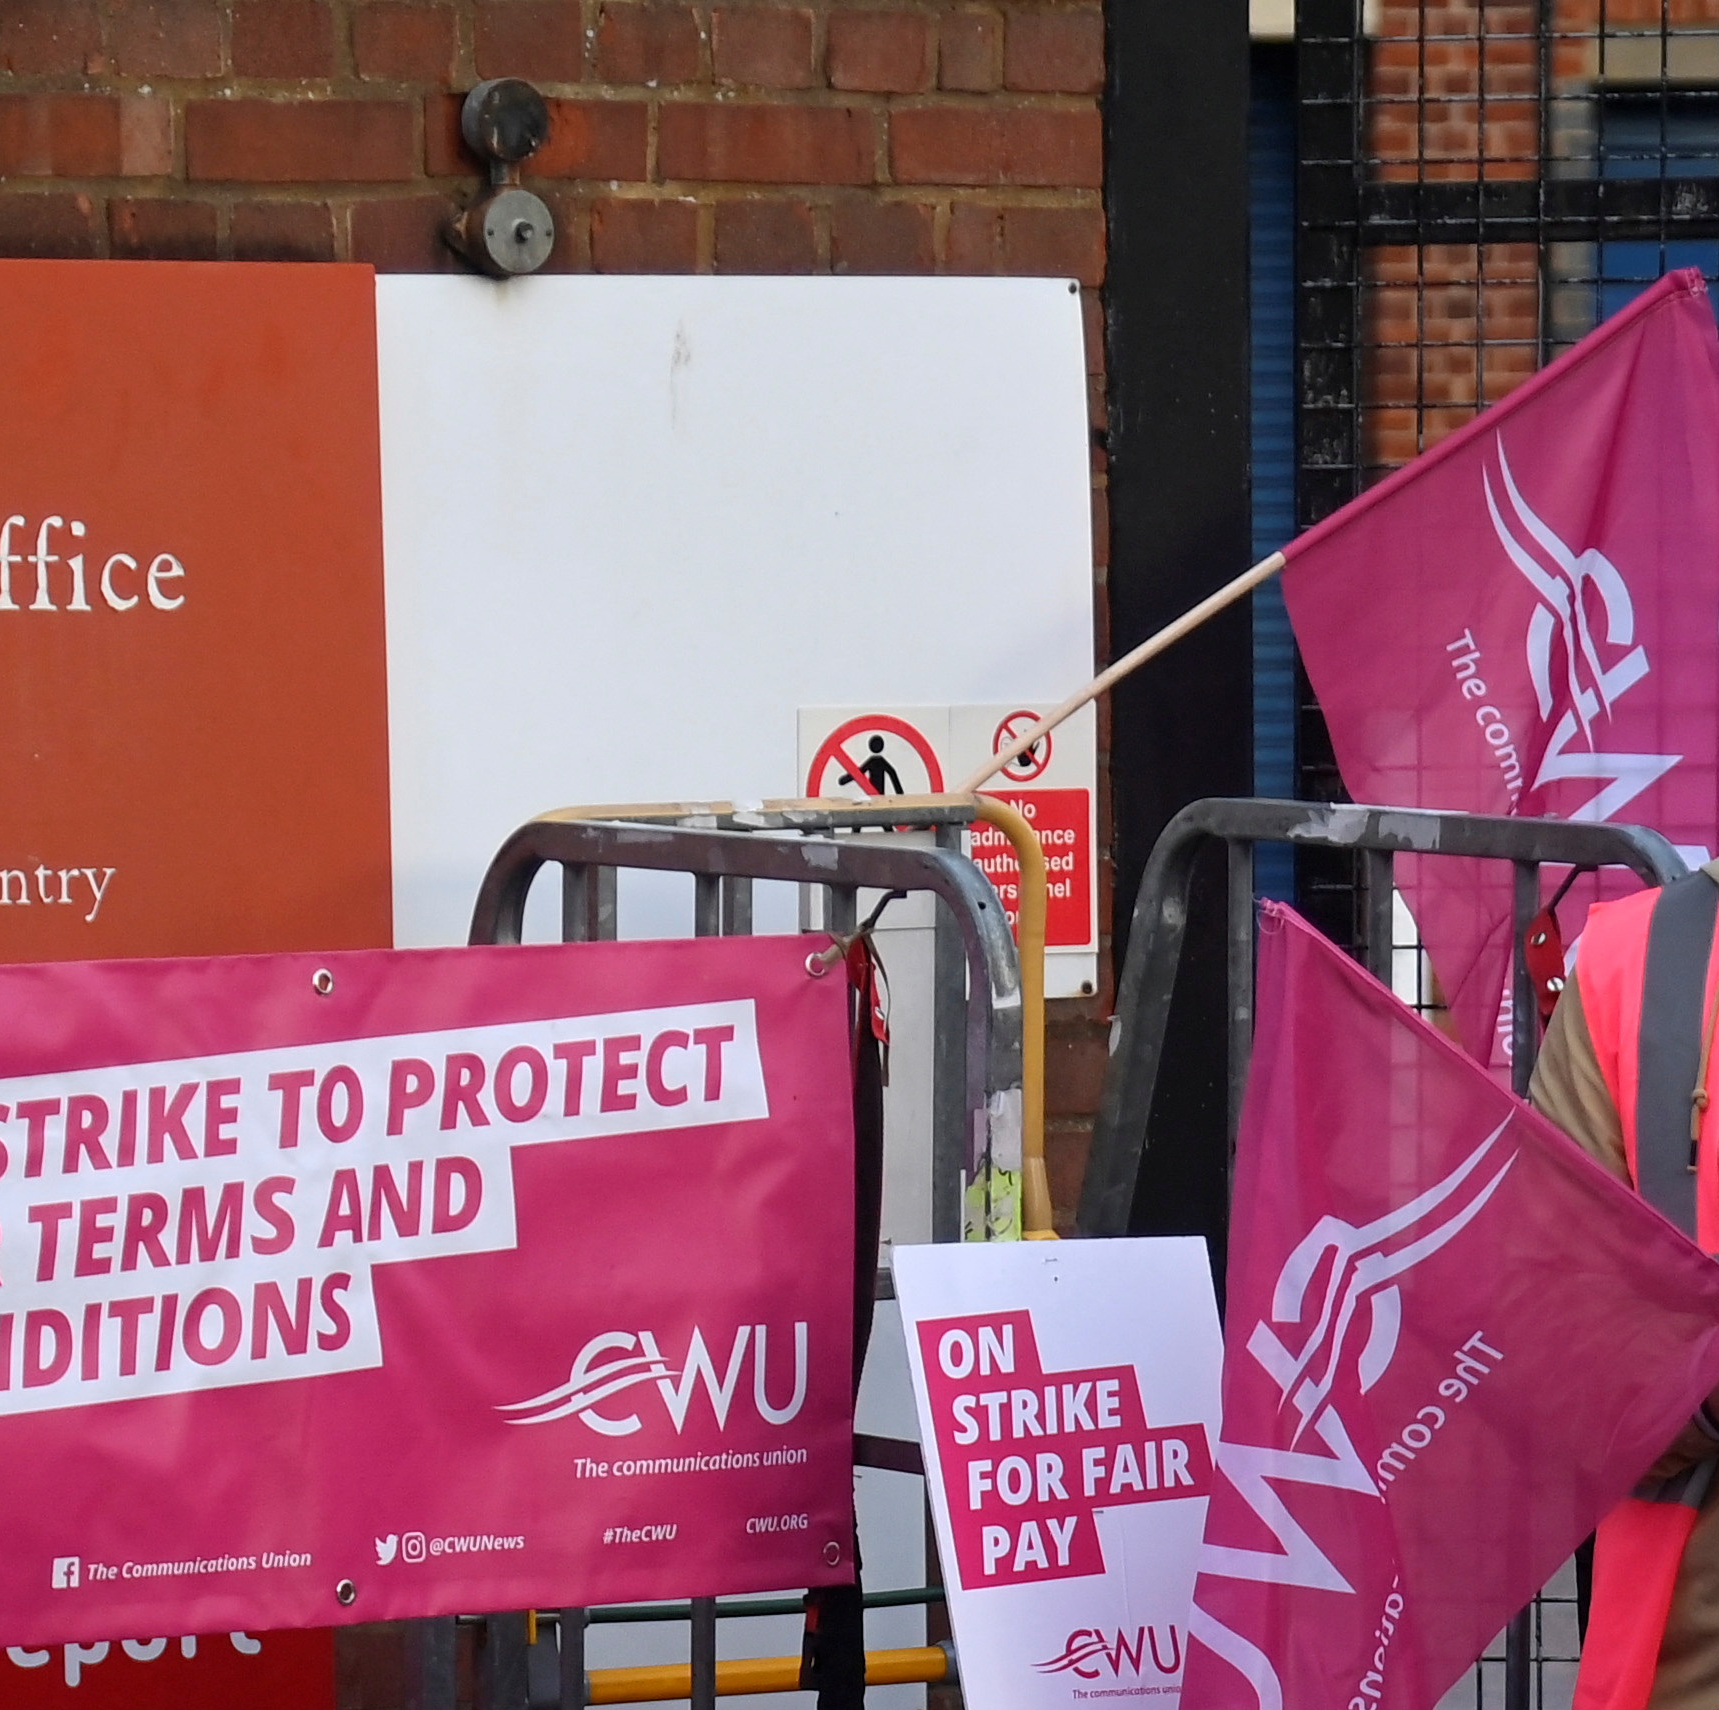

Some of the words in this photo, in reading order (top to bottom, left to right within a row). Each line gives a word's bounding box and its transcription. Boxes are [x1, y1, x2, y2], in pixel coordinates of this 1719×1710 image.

[1446, 628, 1488, 700] The
[268, 1062, 367, 1150] TO
[387, 1024, 735, 1138] PROTECT
[27, 1174, 296, 1282] TERMS
[319, 1155, 483, 1250] AND
[567, 1320, 809, 1438] CWU
[939, 1324, 1015, 1379] ON
[952, 1379, 1121, 1445] STRIKE
[573, 1456, 610, 1480] The
[613, 1447, 760, 1477] communications
[763, 1444, 808, 1467] union
[968, 1453, 1069, 1510] FOR
[1082, 1439, 1195, 1498] FAIR
[428, 1533, 525, 1559] @CWUNews
[602, 1523, 678, 1547] #TheCWU
[744, 1513, 809, 1536] CWU.ORG
[982, 1515, 1078, 1576] PAY
[86, 1562, 117, 1582] The
[121, 1553, 257, 1579] Communications
[260, 1550, 312, 1572] Union
[1065, 1624, 1180, 1679] CWU
